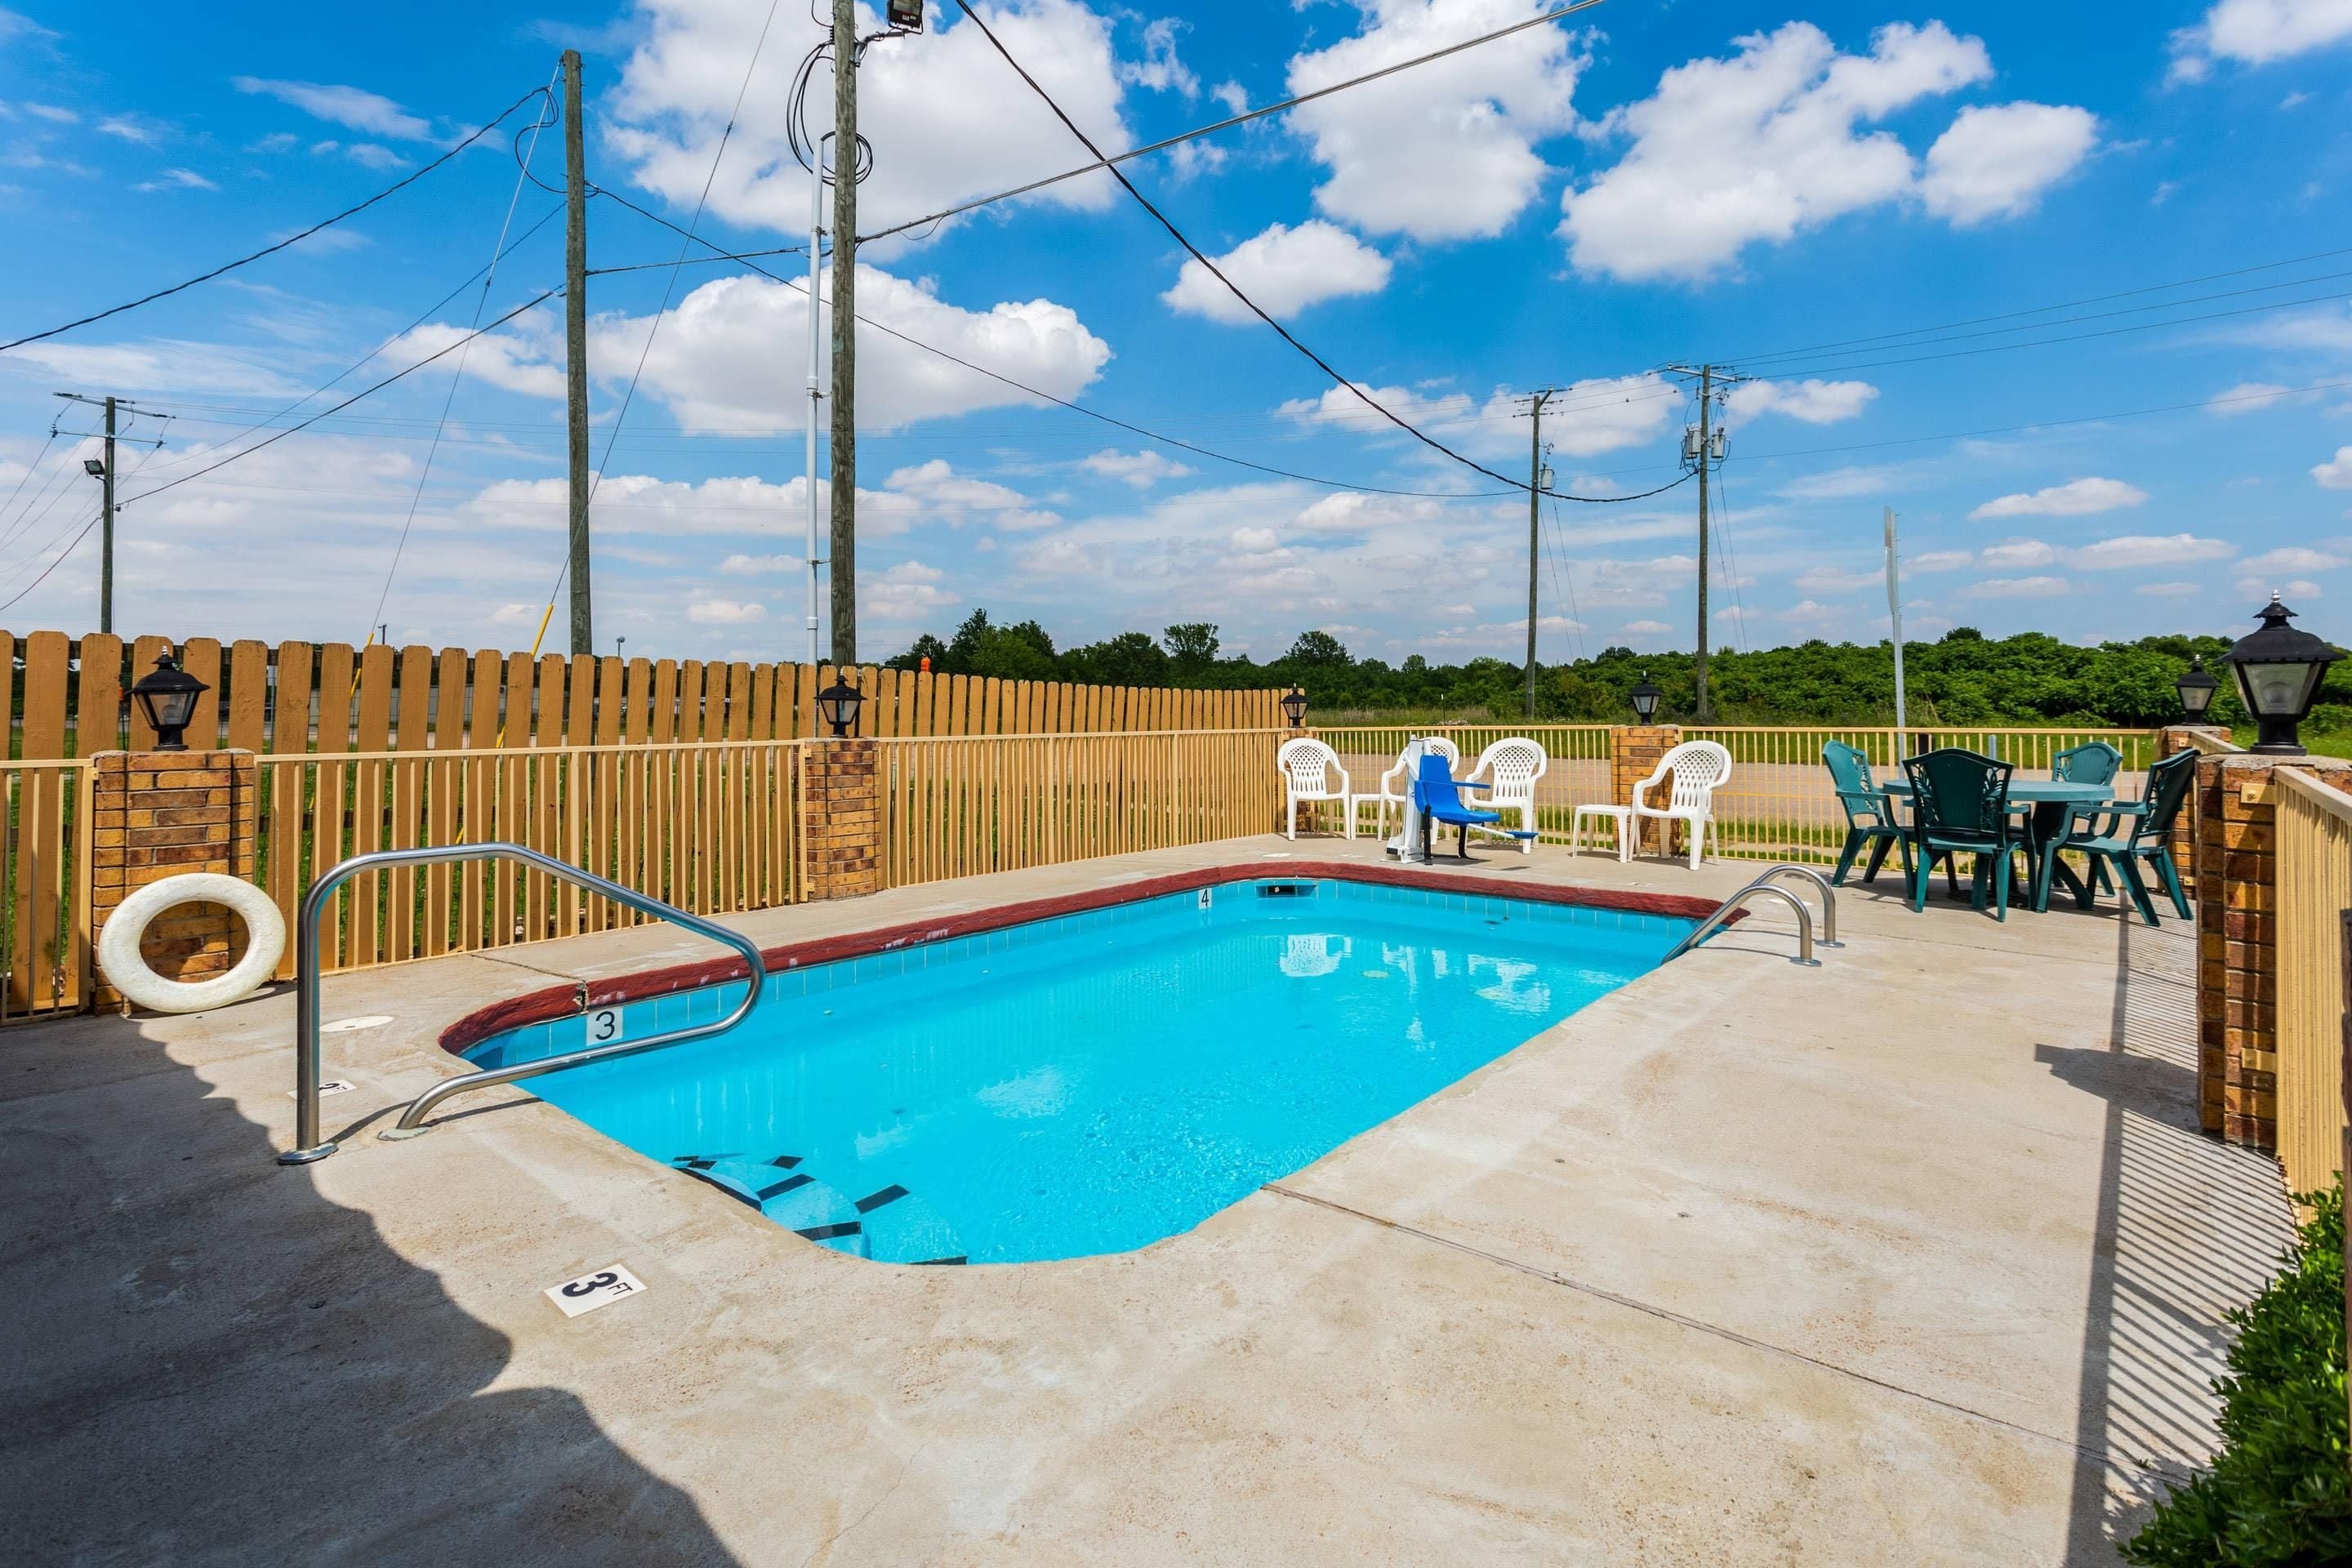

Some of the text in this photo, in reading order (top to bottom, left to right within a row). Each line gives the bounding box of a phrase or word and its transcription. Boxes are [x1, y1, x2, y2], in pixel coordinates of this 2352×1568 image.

[1201, 889, 1209, 906] 4
[595, 1010, 615, 1040] 3
[562, 1272, 634, 1298] 3 FT
